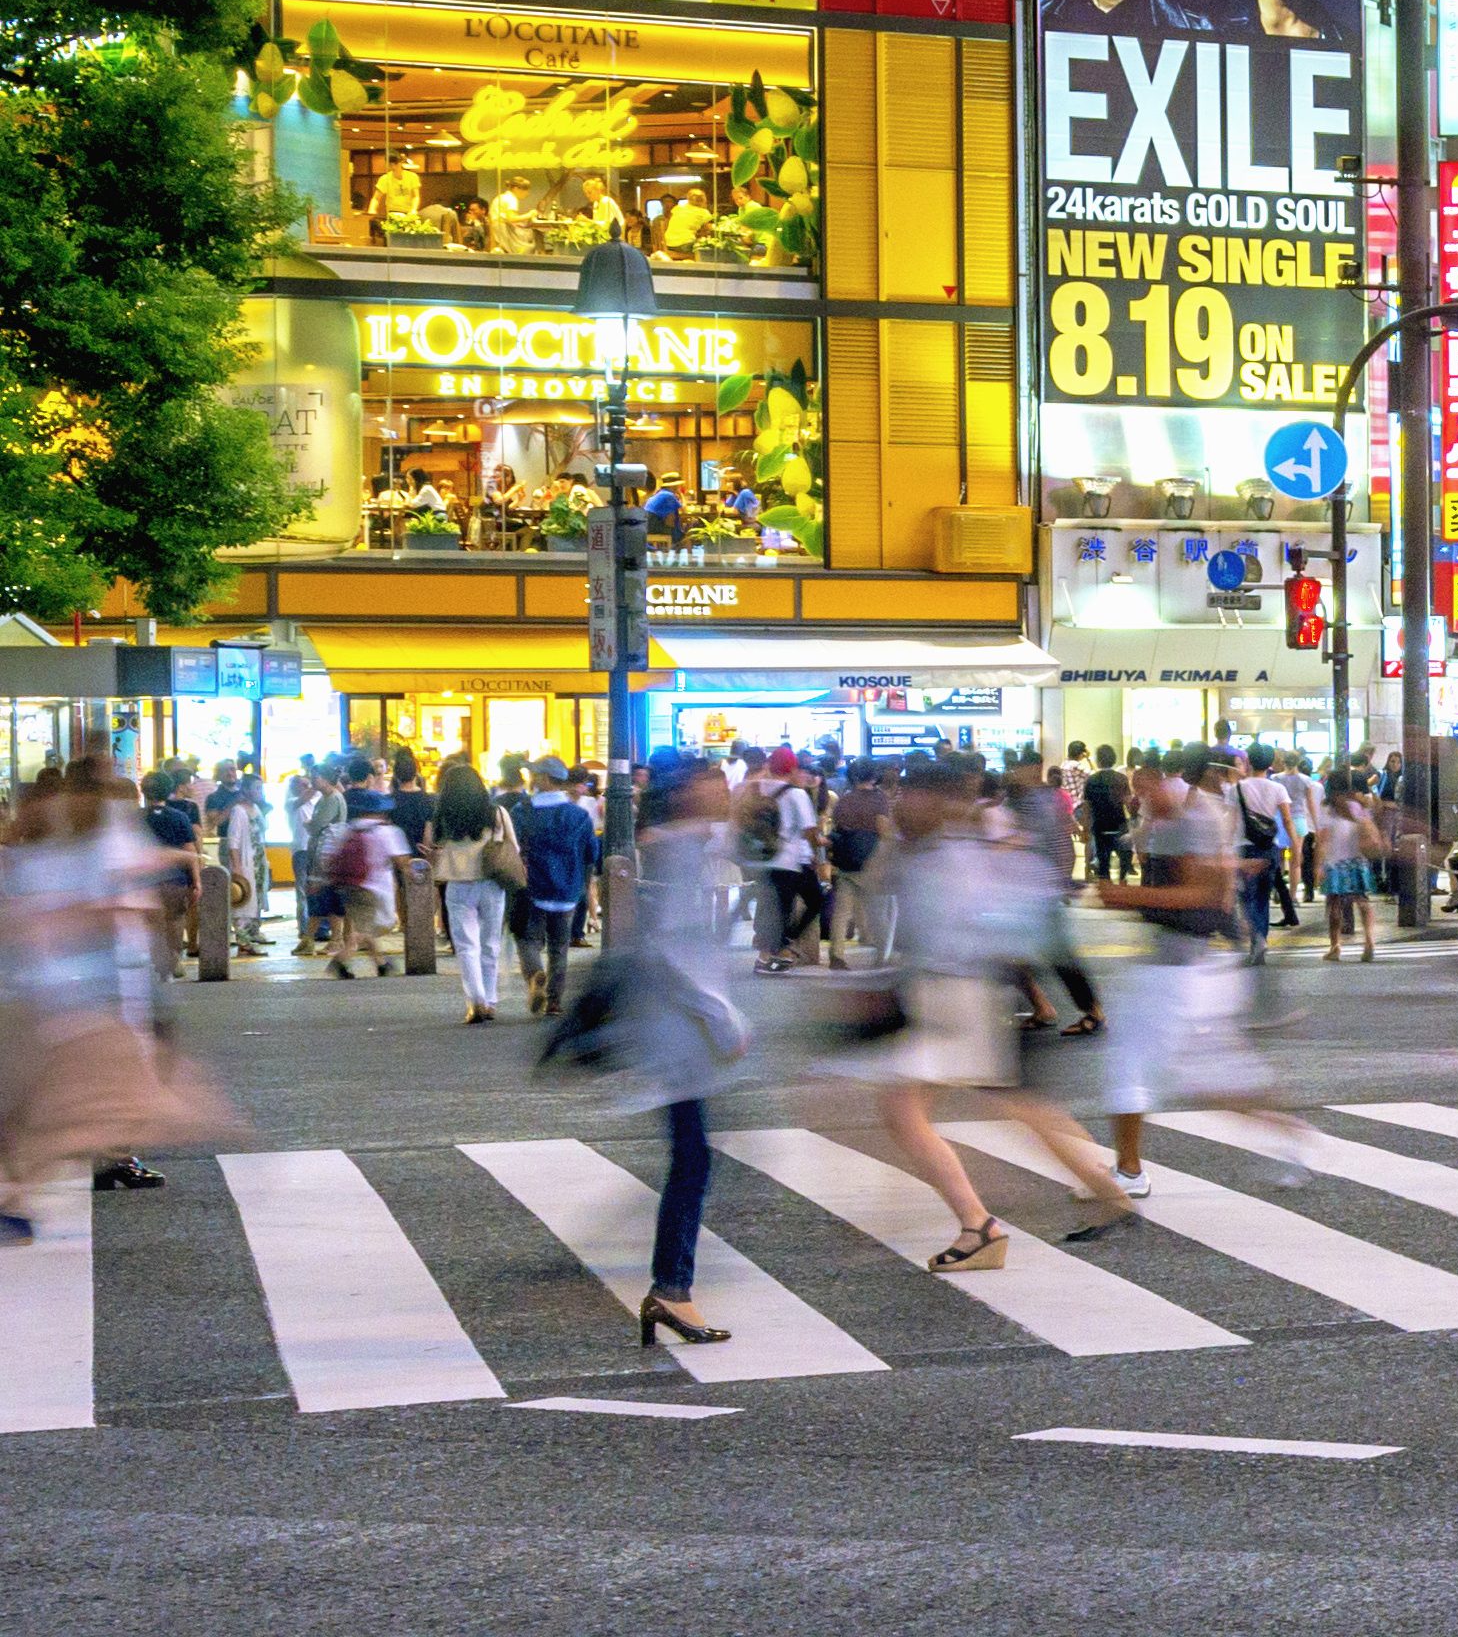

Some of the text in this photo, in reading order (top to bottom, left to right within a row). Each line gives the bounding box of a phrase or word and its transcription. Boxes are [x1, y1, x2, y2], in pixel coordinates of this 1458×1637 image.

[463, 15, 639, 48] L'OCCITANE
[523, 47, 582, 72] Café
[1044, 30, 1354, 197] EXILE
[1046, 187, 1356, 235] 24karats GOLD SOUL
[1046, 228, 1355, 290] NEW SINGLE
[365, 307, 740, 374] L'OCCITANE
[1049, 281, 1294, 401] 8.19 ON
[439, 374, 482, 394] EN
[460, 677, 553, 692] L'OCCITANE
[839, 675, 912, 688] KIOSQUE
[1060, 670, 1239, 683] SHIBUYA EKIMAE
